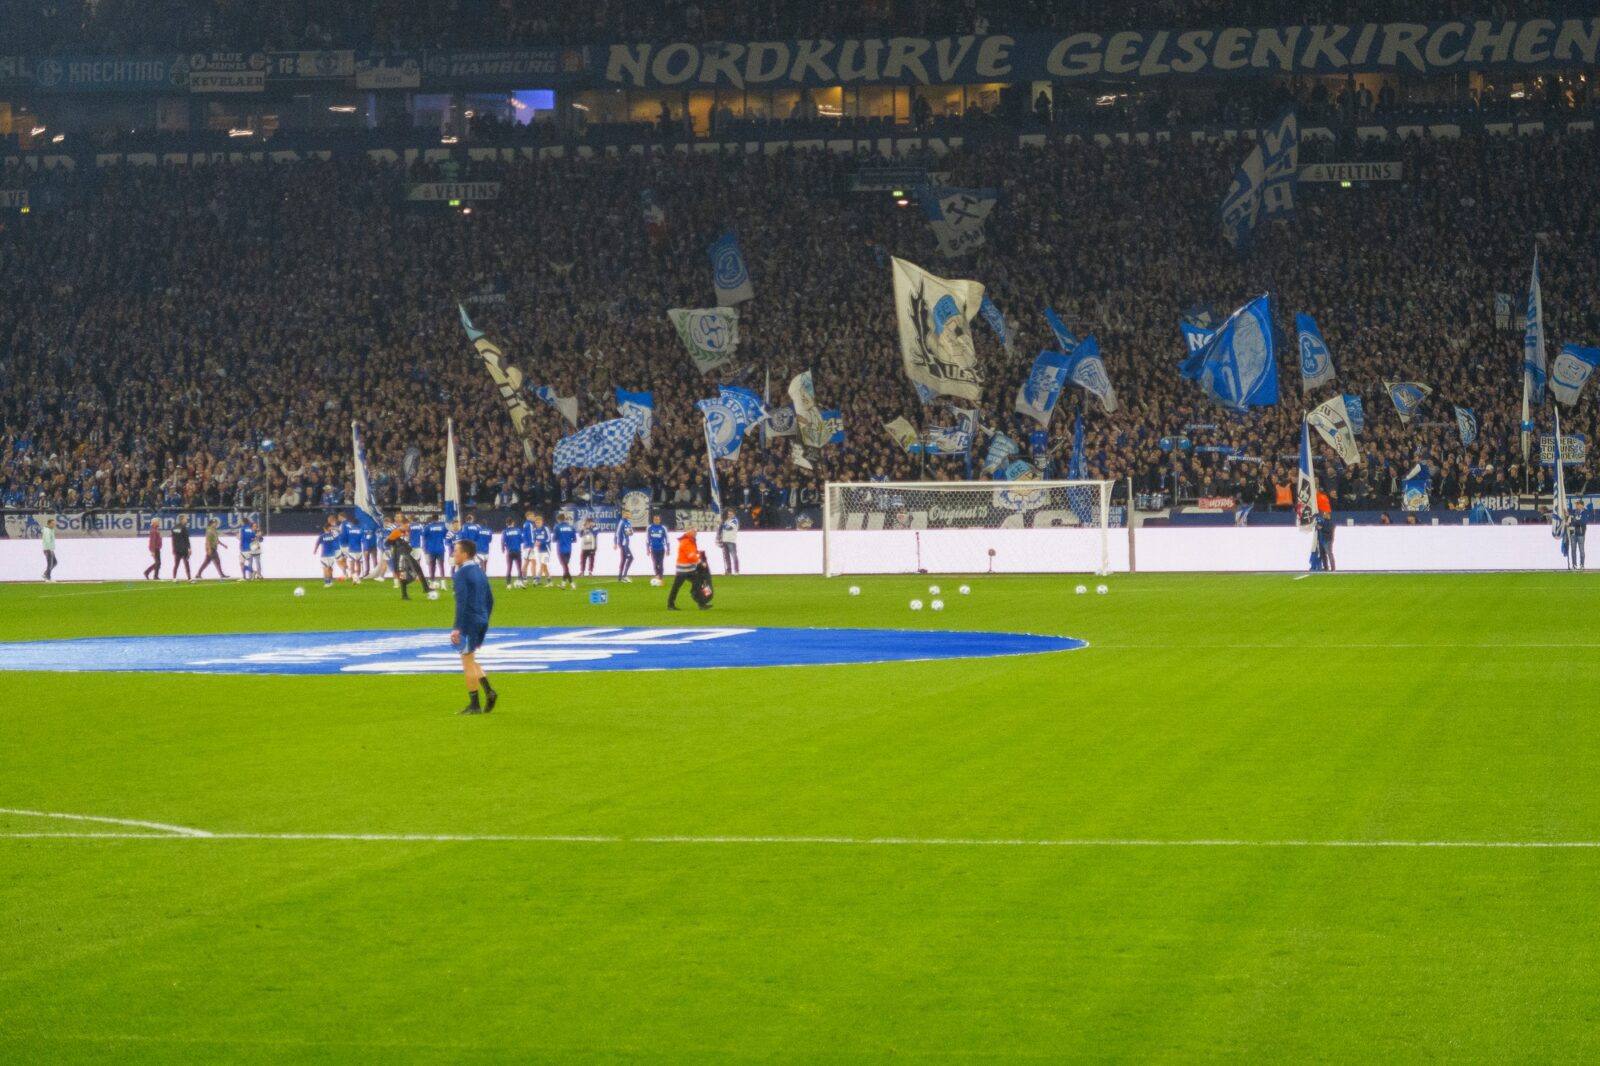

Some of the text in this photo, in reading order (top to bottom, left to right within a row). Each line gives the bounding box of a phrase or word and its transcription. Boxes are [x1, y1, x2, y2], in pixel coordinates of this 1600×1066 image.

[211, 52, 243, 62] BLUE
[605, 17, 1600, 89] NORDKURVE GELSENKIRCHEN
[450, 60, 557, 76] HAMBURG
[191, 76, 263, 87] KEVELAER
[1325, 163, 1392, 181] VELTINS
[434, 184, 498, 199] VELTINS
[1470, 494, 1520, 512] MARLER
[56, 513, 133, 530] Schalke
